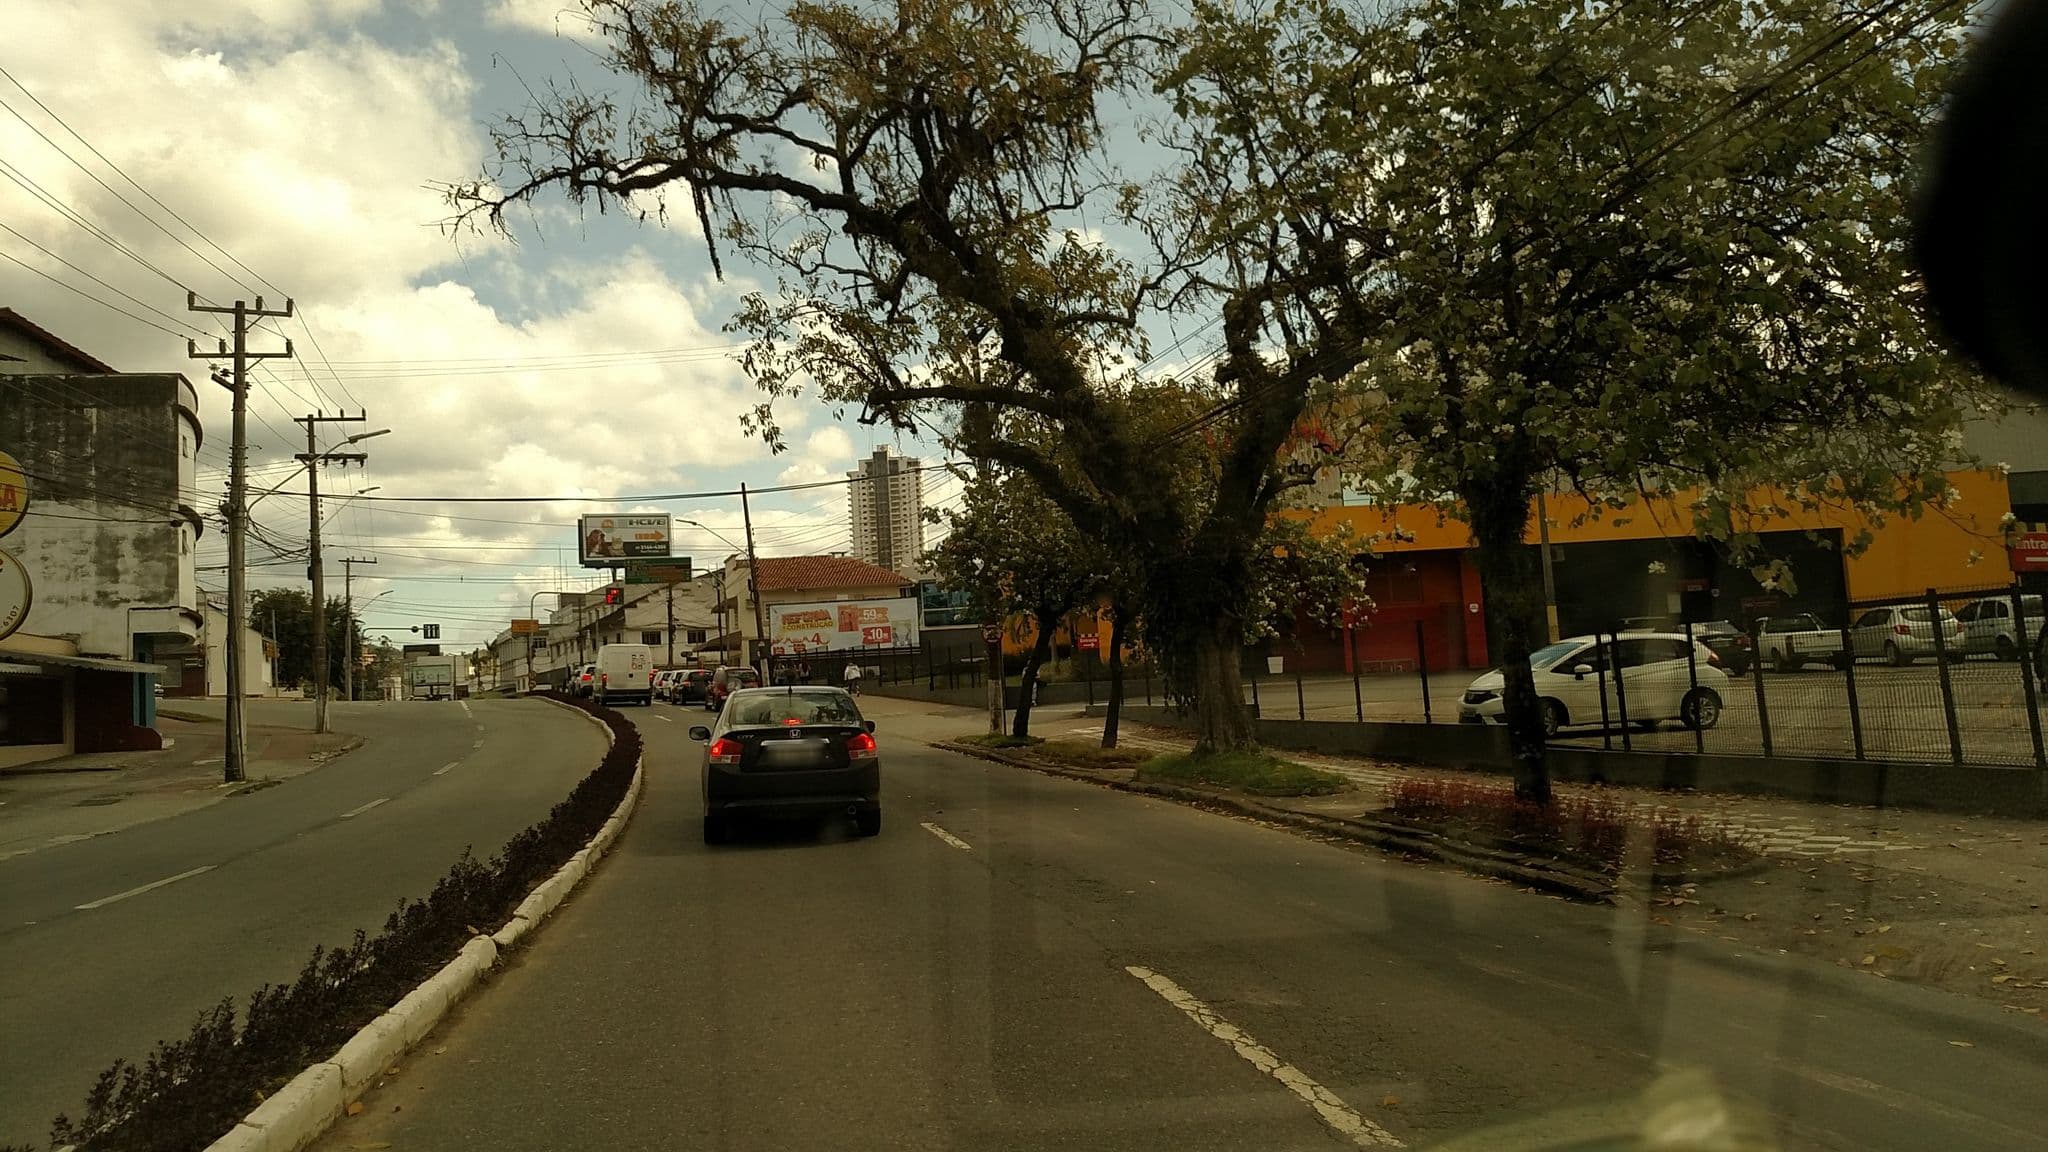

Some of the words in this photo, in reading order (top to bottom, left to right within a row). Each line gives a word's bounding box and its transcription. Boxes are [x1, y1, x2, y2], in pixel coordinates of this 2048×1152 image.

[863, 609, 876, 621] 59
[812, 633, 821, 646] 4
[870, 628, 884, 640] 10
